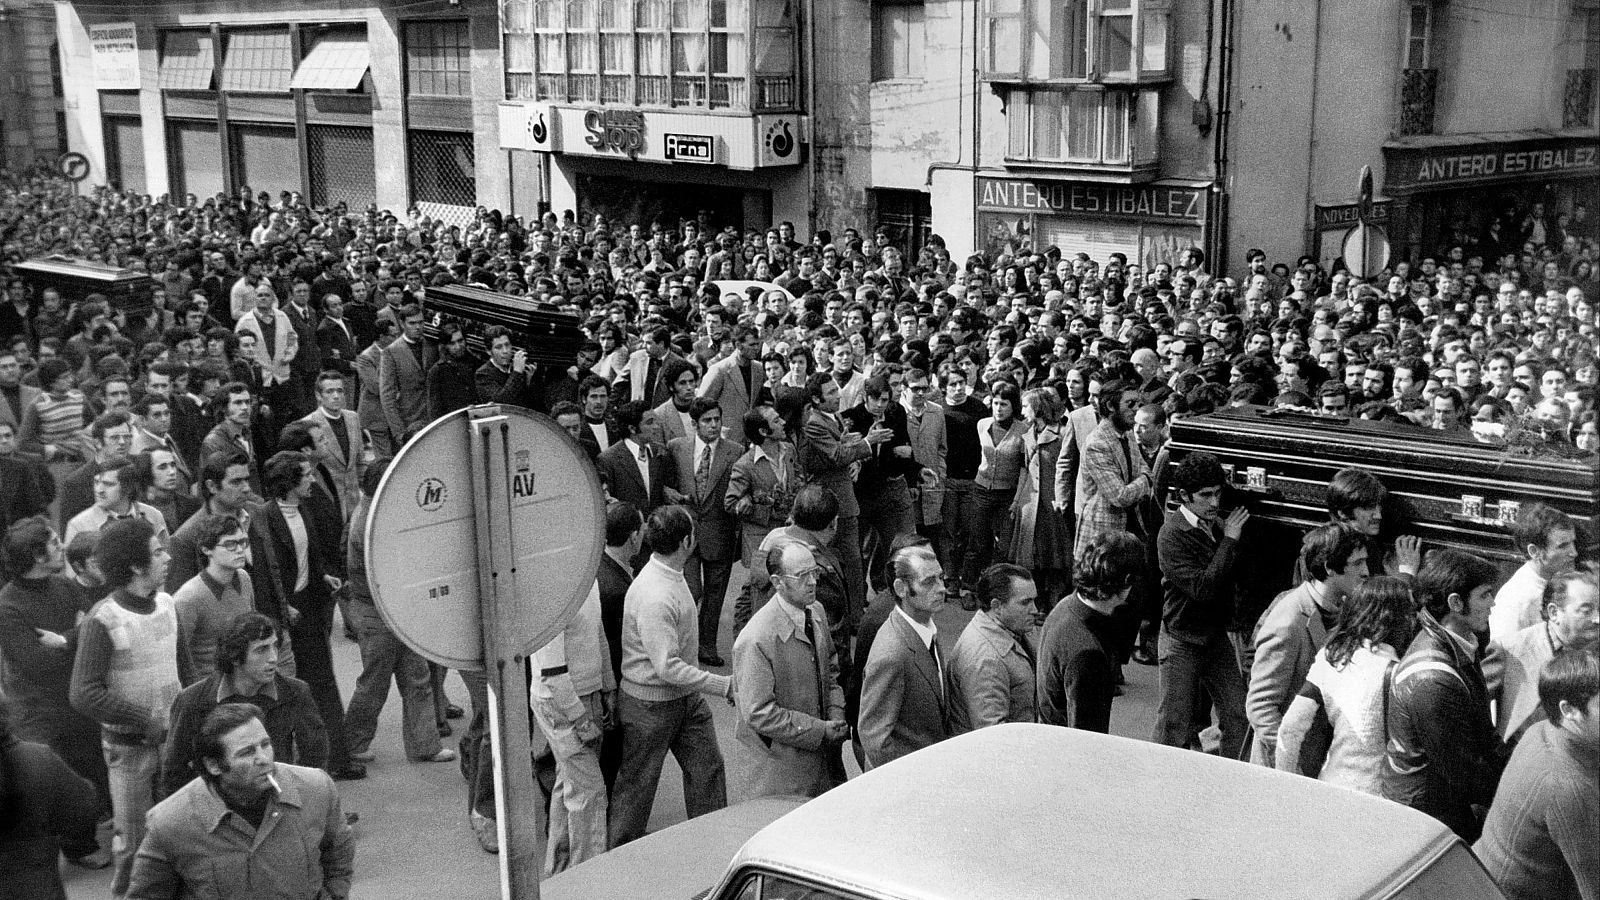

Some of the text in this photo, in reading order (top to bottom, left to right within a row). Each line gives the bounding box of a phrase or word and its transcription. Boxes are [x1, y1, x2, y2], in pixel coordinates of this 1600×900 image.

[1421, 147, 1596, 181] ANTERO ESTIBALEZ
[982, 181, 1200, 218] ANTERO ESTIBALEZ
[1323, 204, 1386, 222] NOVEDES
